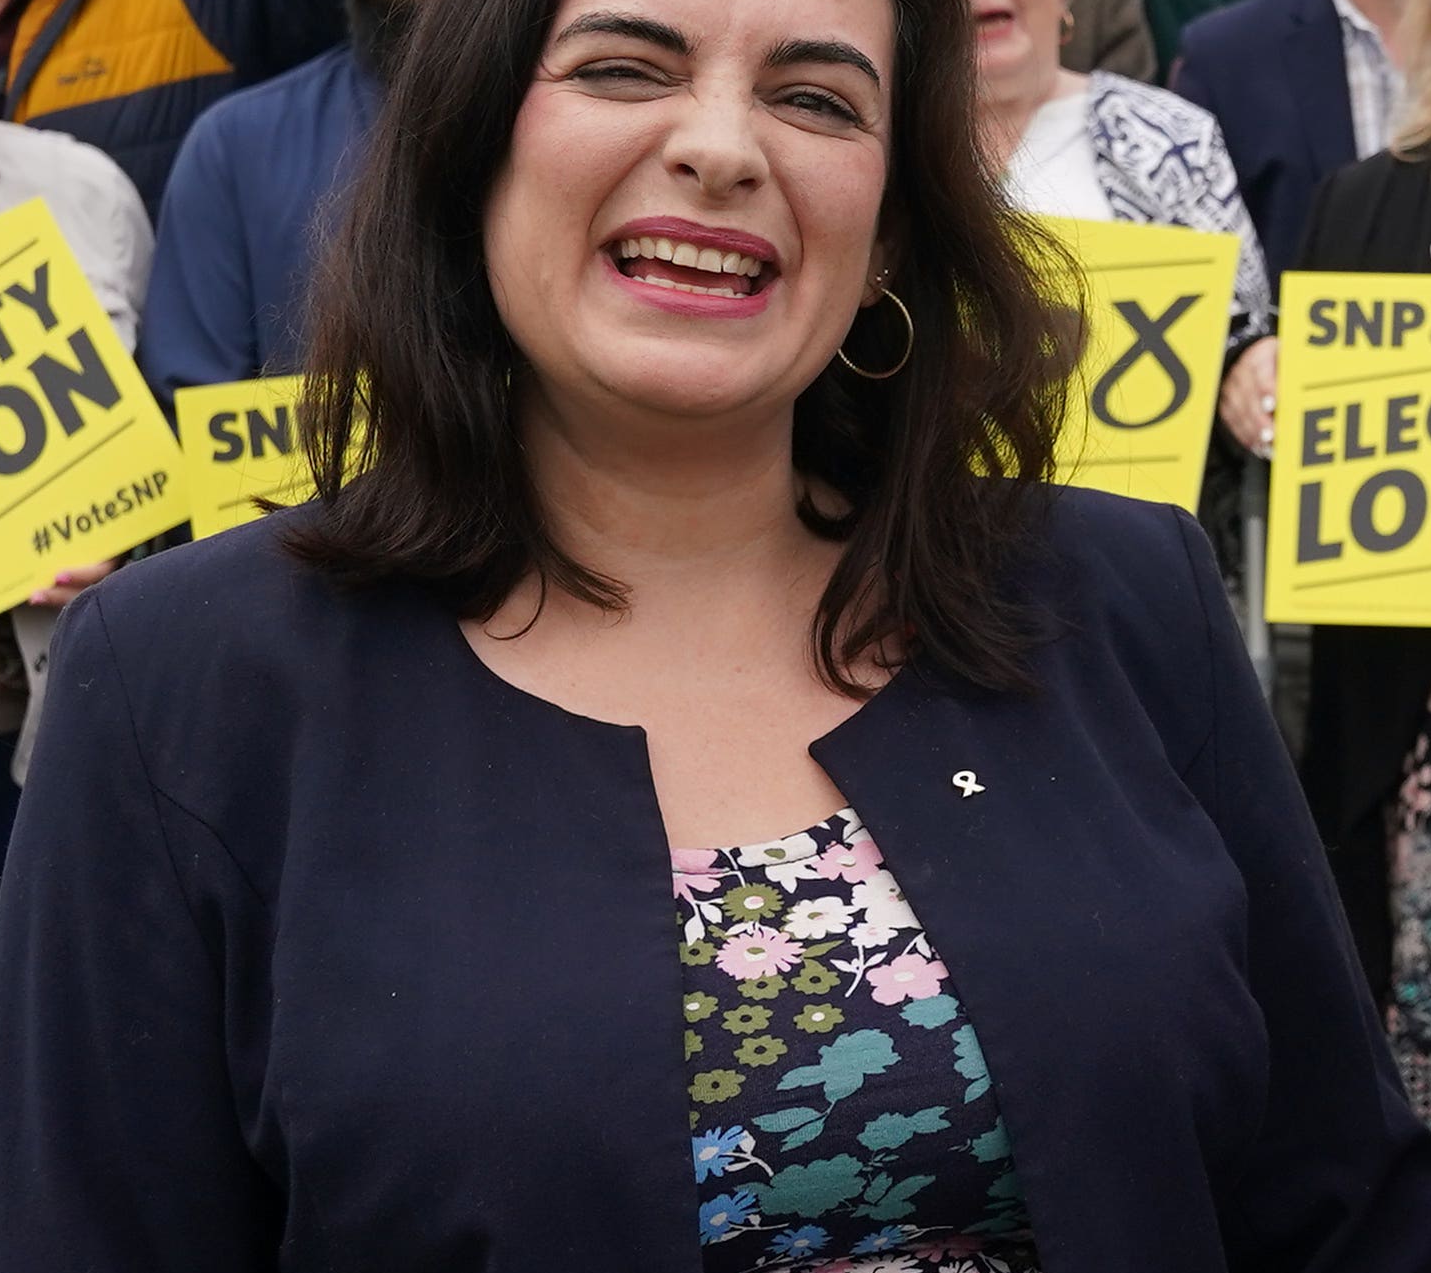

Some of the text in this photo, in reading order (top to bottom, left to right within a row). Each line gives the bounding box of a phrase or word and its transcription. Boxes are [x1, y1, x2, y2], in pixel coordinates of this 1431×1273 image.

[1305, 299, 1425, 348] SNP
[208, 406, 292, 463] SN
[32, 470, 170, 557] #VoteSNP
